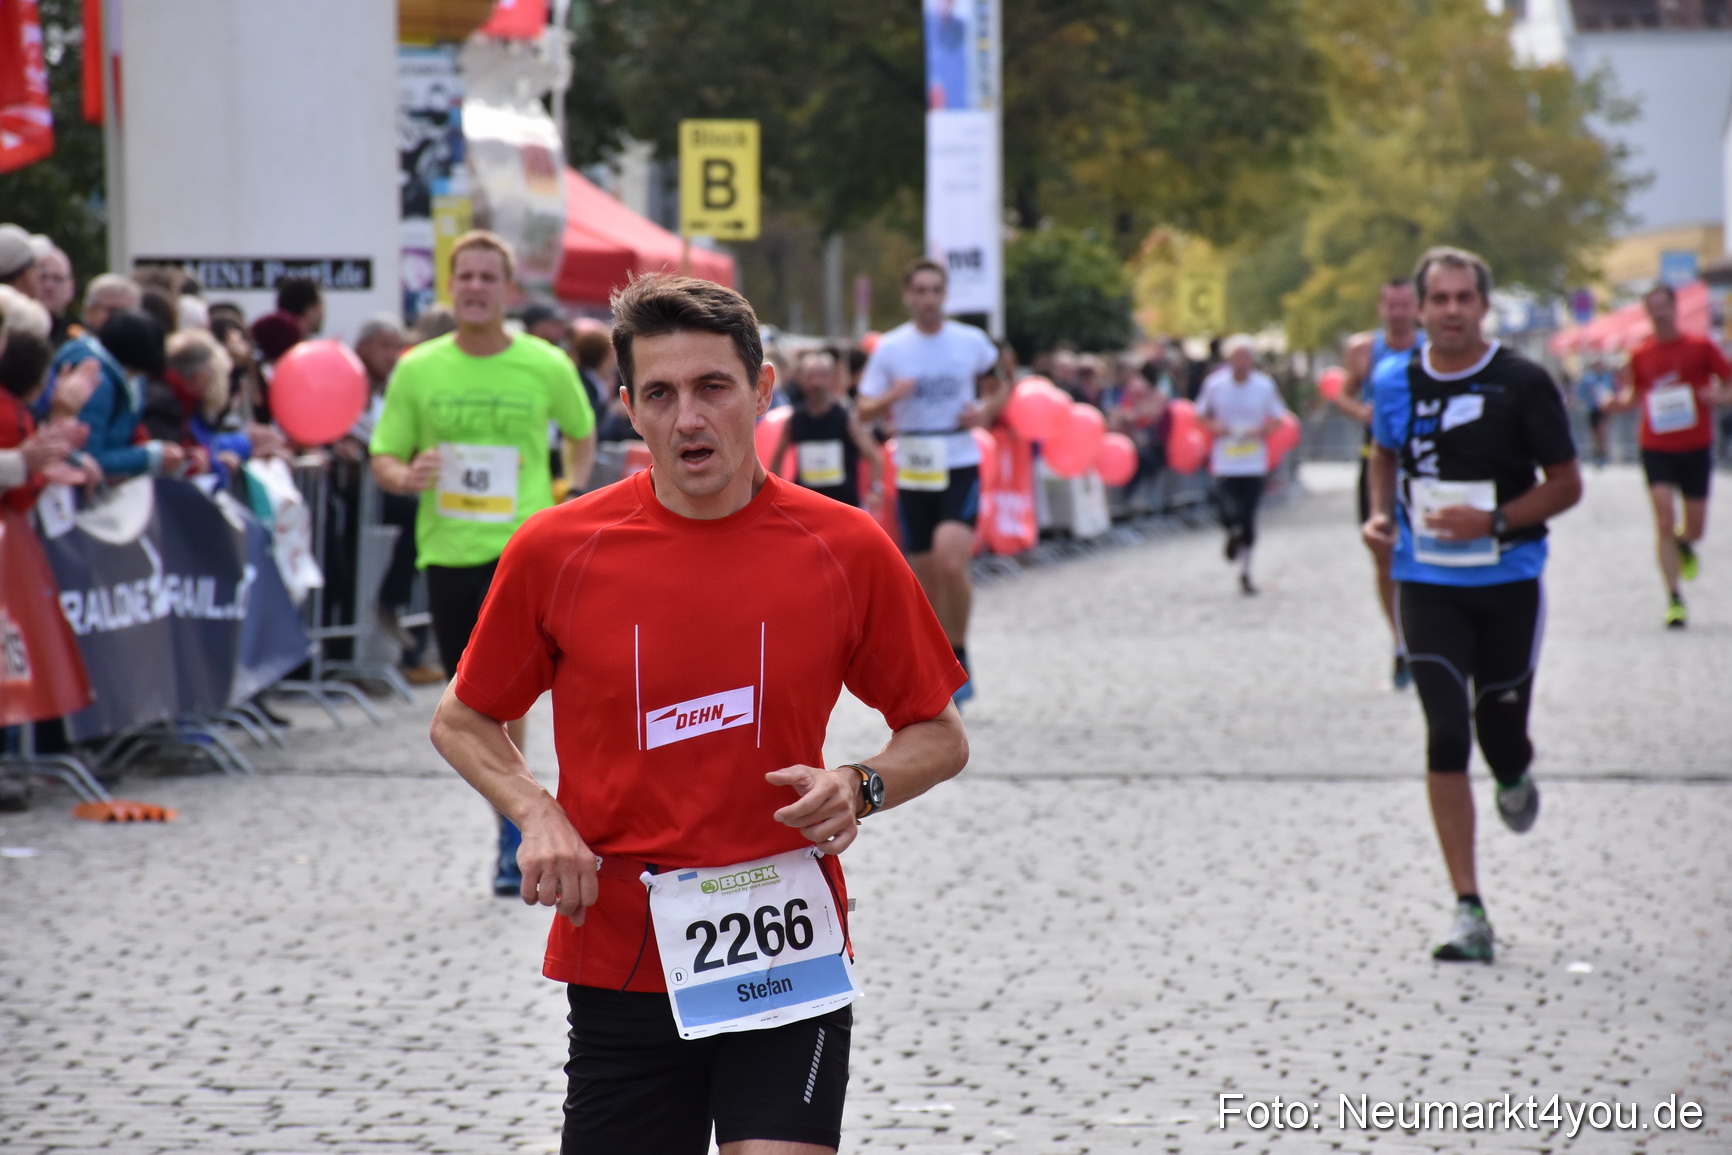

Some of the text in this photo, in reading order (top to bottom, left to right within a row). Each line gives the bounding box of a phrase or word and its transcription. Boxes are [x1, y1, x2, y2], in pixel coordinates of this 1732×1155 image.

[703, 158, 737, 210] B
[462, 469, 490, 492] 48
[675, 703, 725, 731] DEHN
[719, 865, 780, 890] BOCK
[685, 898, 814, 974] 2266
[675, 972, 683, 982] D
[736, 977, 793, 1002] Stefan
